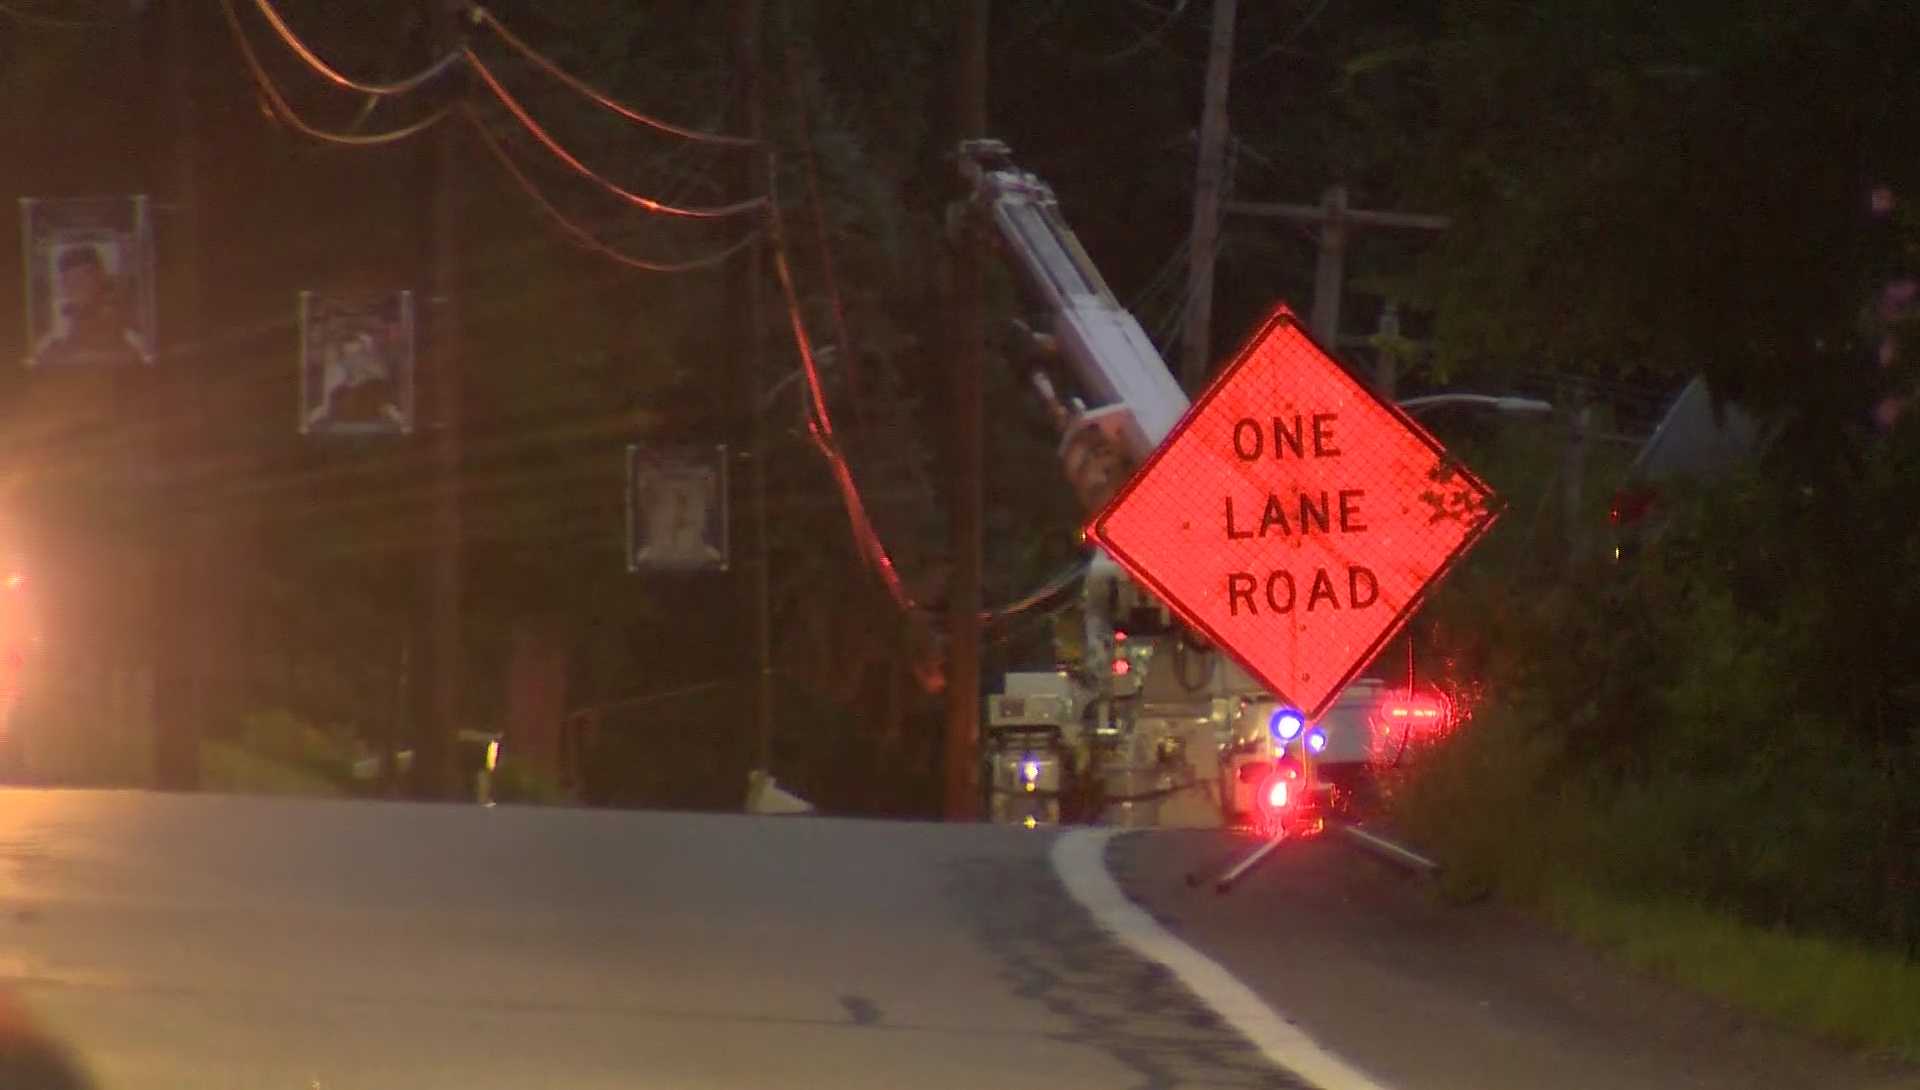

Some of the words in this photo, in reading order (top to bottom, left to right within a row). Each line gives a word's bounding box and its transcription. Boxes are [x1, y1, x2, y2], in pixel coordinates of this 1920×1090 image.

[1233, 413, 1342, 462] ONE
[1226, 489, 1368, 540] LANE
[1228, 565, 1380, 617] ROAD
